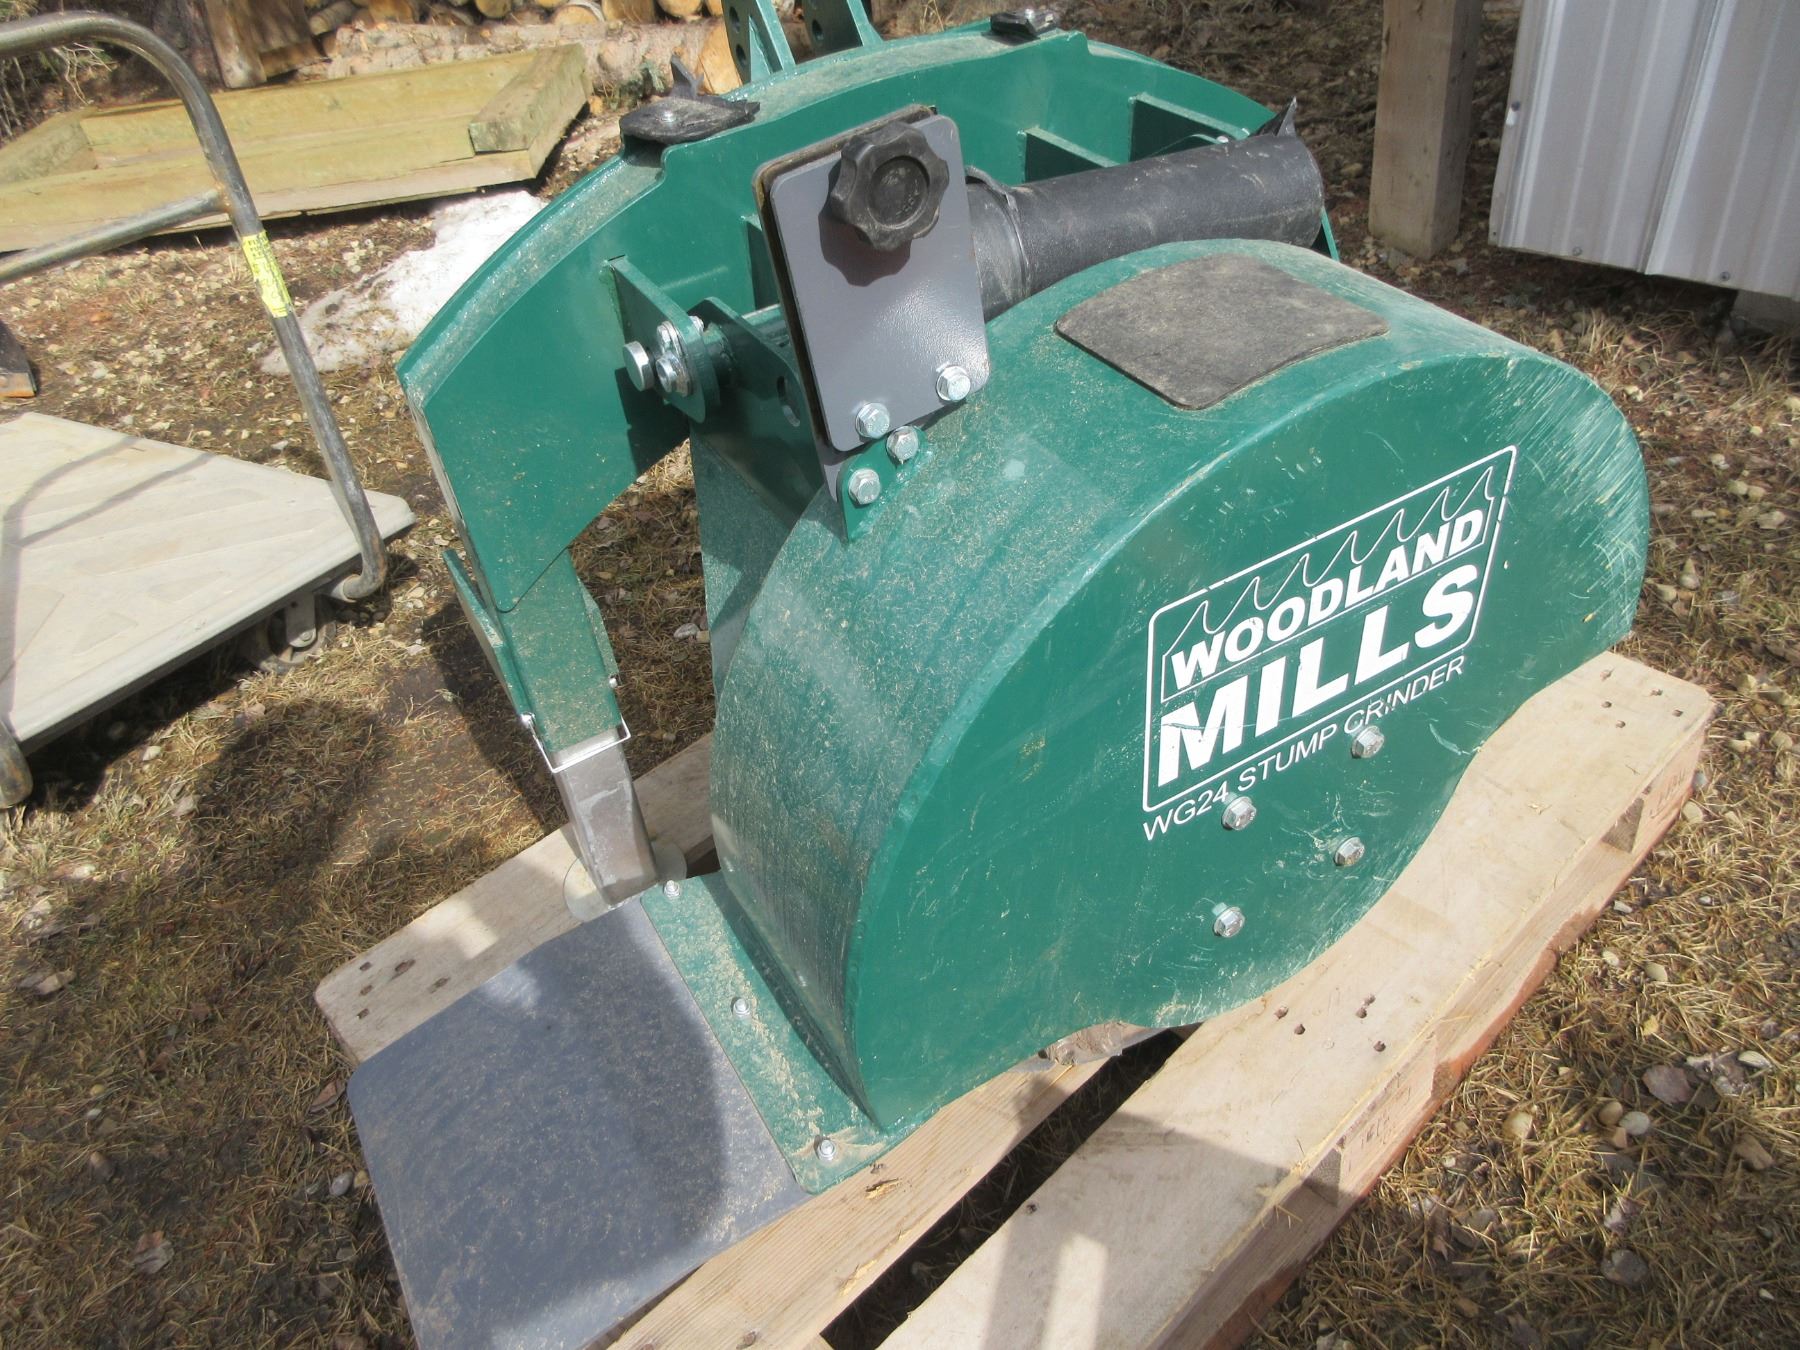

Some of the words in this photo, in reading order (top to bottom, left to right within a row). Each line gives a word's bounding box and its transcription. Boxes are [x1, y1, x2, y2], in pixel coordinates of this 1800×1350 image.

[1157, 564, 1479, 787] MILLS
[1171, 509, 1485, 690] WOODLAND
[1142, 781, 1229, 841] WG24
[1238, 723, 1338, 793] STUMP
[1343, 655, 1466, 736] GRINDER
